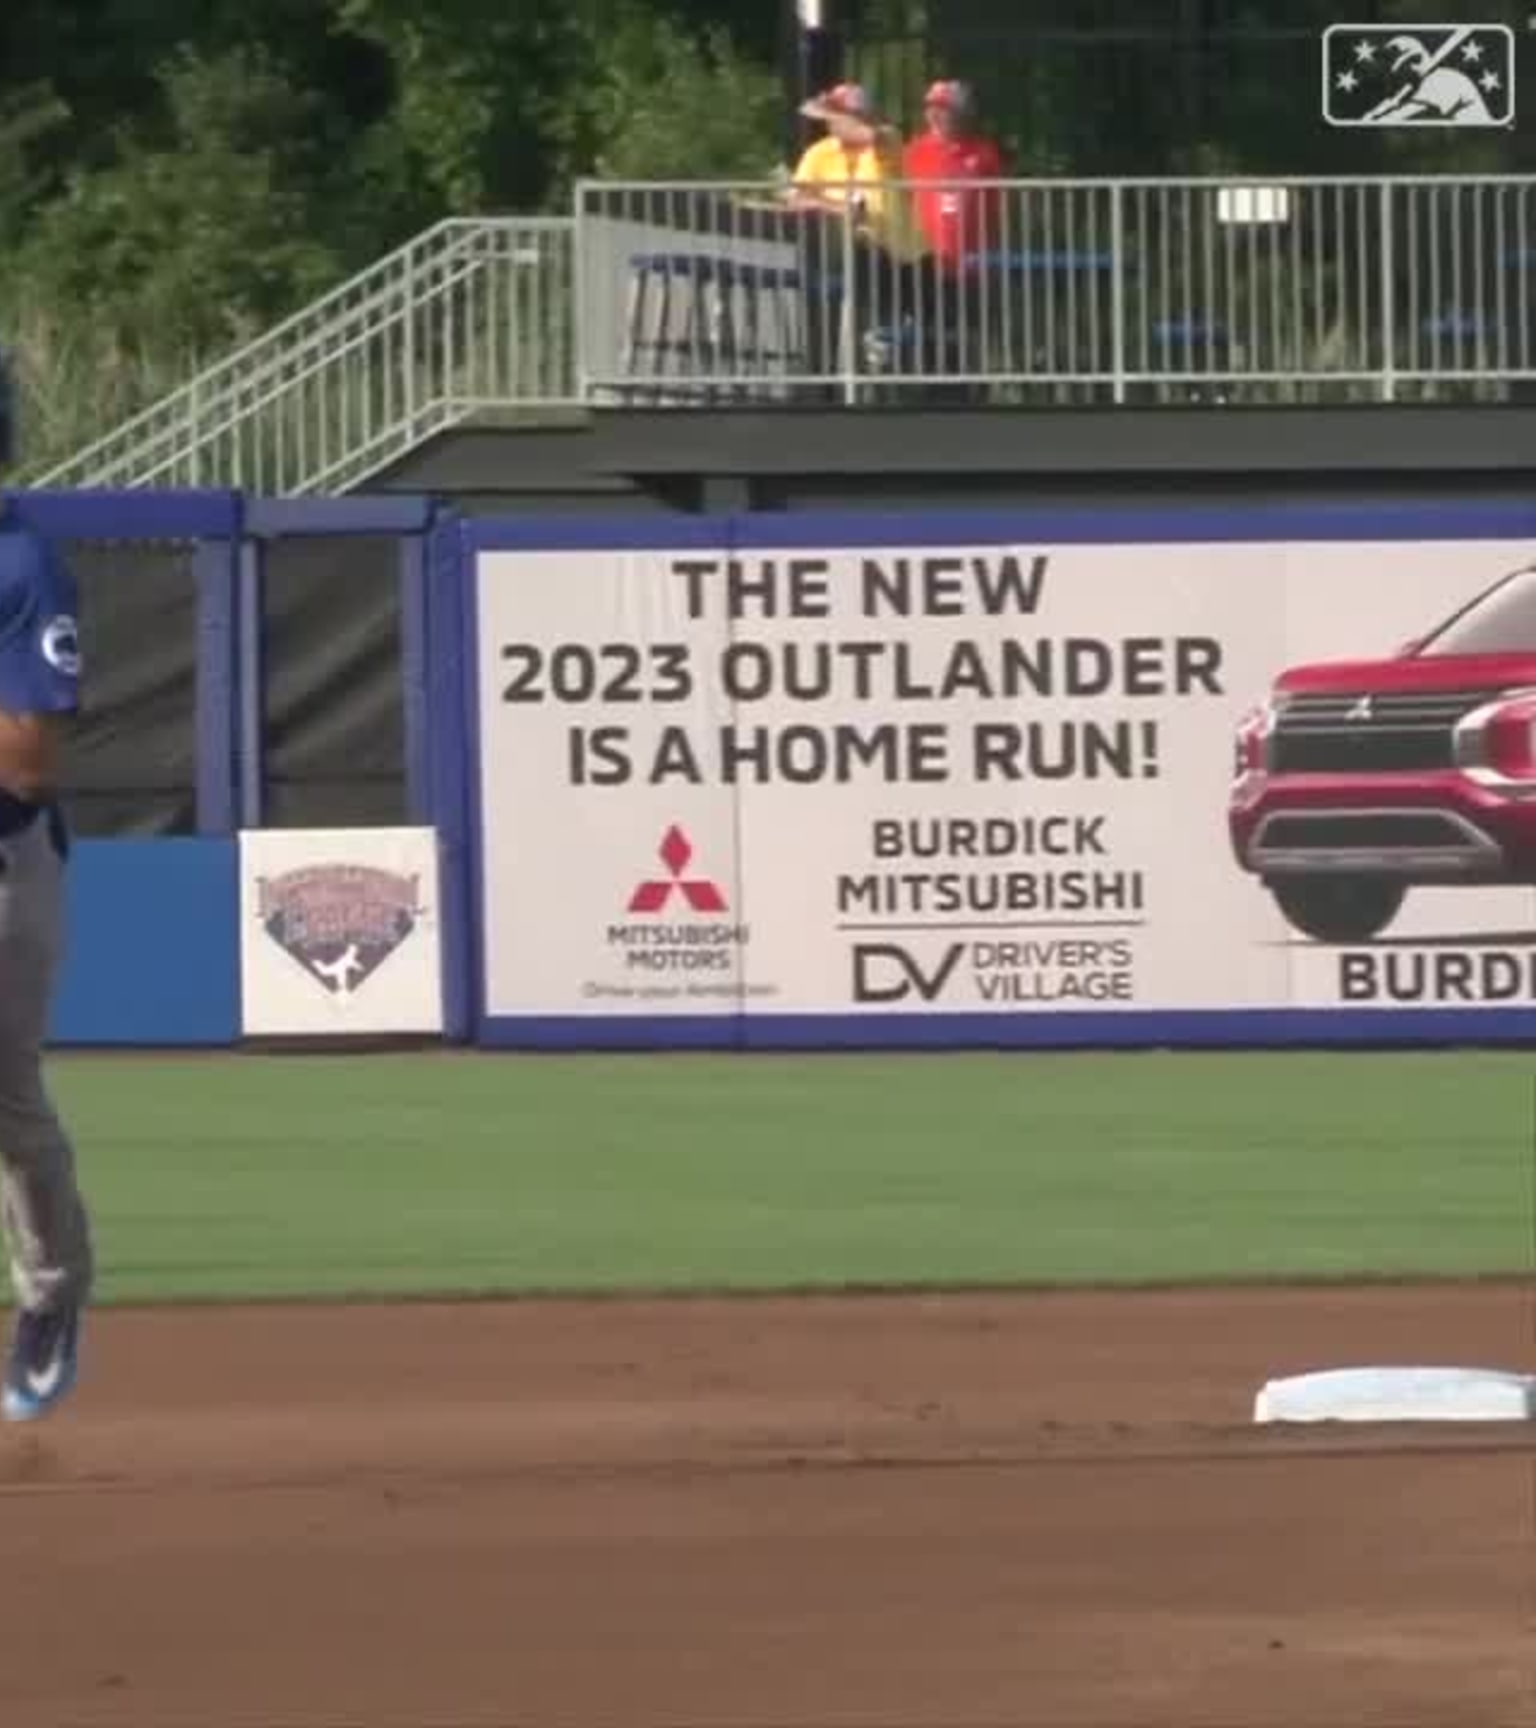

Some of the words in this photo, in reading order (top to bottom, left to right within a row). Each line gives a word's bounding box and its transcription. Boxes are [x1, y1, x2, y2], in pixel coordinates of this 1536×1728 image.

[672, 561, 830, 618] THE
[862, 557, 1048, 616] NEW
[500, 644, 693, 703] 2023
[721, 638, 1224, 702] OUTLANDER
[568, 728, 631, 786] IS
[650, 726, 702, 785] A
[719, 725, 950, 784] HOME
[973, 721, 1160, 780] RUN!
[872, 816, 1106, 858] BURDICK
[837, 871, 1144, 913] MITSUBISHI
[606, 924, 750, 945] MITSUBISHI
[971, 940, 1133, 968] DRIVER'S
[626, 949, 730, 971] MOTORS
[852, 942, 967, 1003] DV
[975, 972, 1133, 1002] VILLAGE
